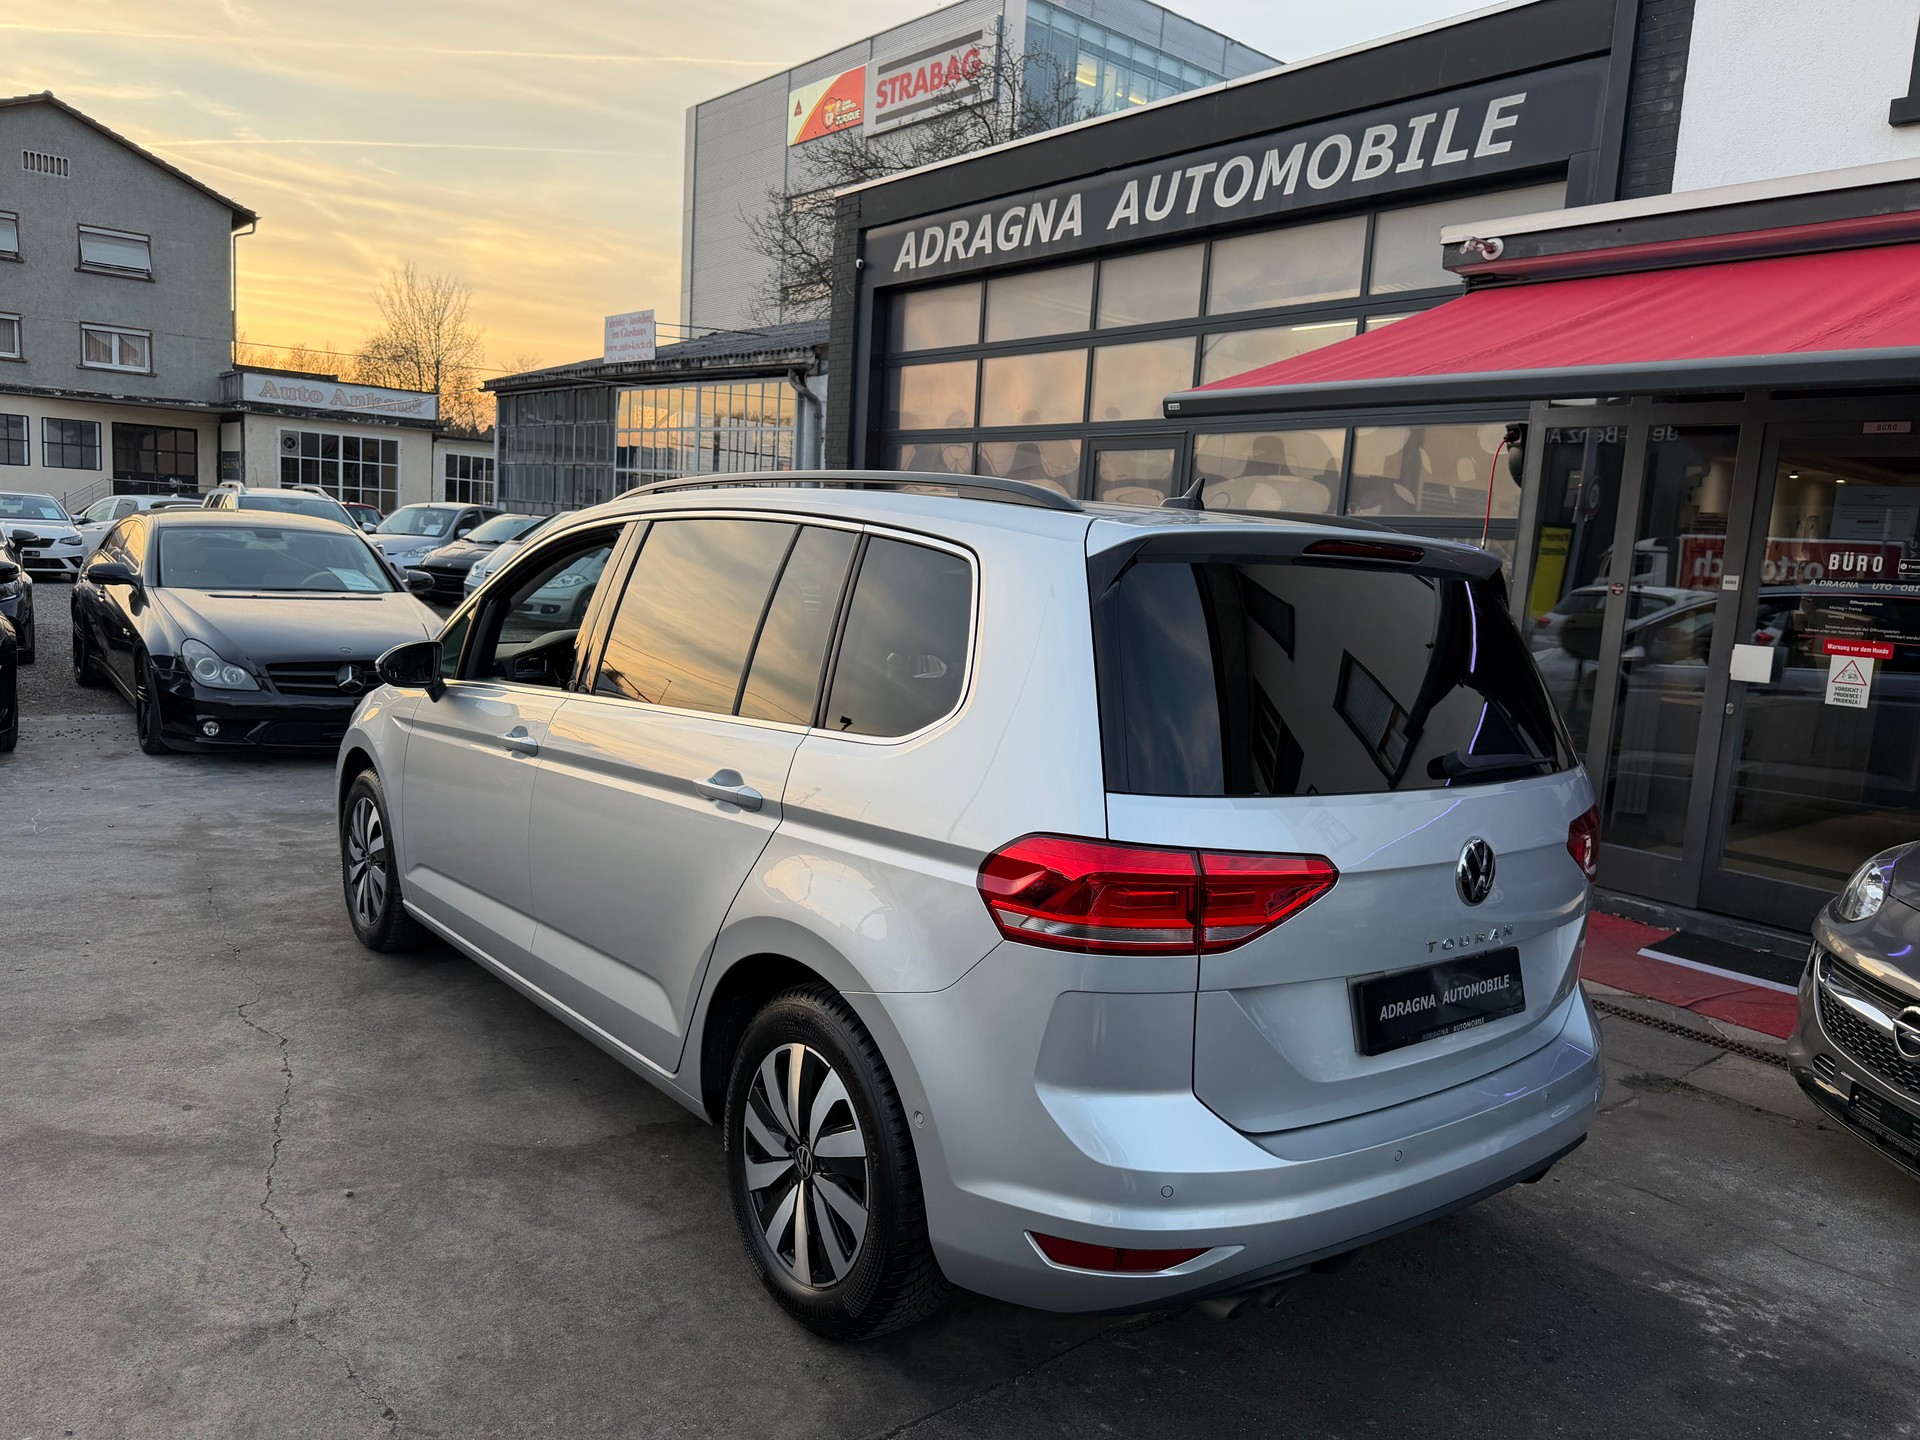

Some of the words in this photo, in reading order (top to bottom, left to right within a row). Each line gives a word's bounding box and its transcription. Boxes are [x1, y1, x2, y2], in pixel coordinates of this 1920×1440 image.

[876, 48, 981, 109] STRABAG
[893, 193, 1082, 273] ADRAGNA
[1107, 92, 1527, 230] AUTOMOBILE
[259, 380, 324, 403] Auto
[329, 388, 423, 414] Ankauf
[1828, 551, 1884, 573] BÜRO
[1827, 643, 1850, 652] Warnung
[1833, 697, 1858, 705] PRUDENZA
[1426, 924, 1513, 953] TOURAN
[1379, 994, 1436, 1021] ADRAGNA
[1442, 974, 1510, 1005] AUTOMOBILE
[1453, 1017, 1485, 1033] AUTOMOBILE
